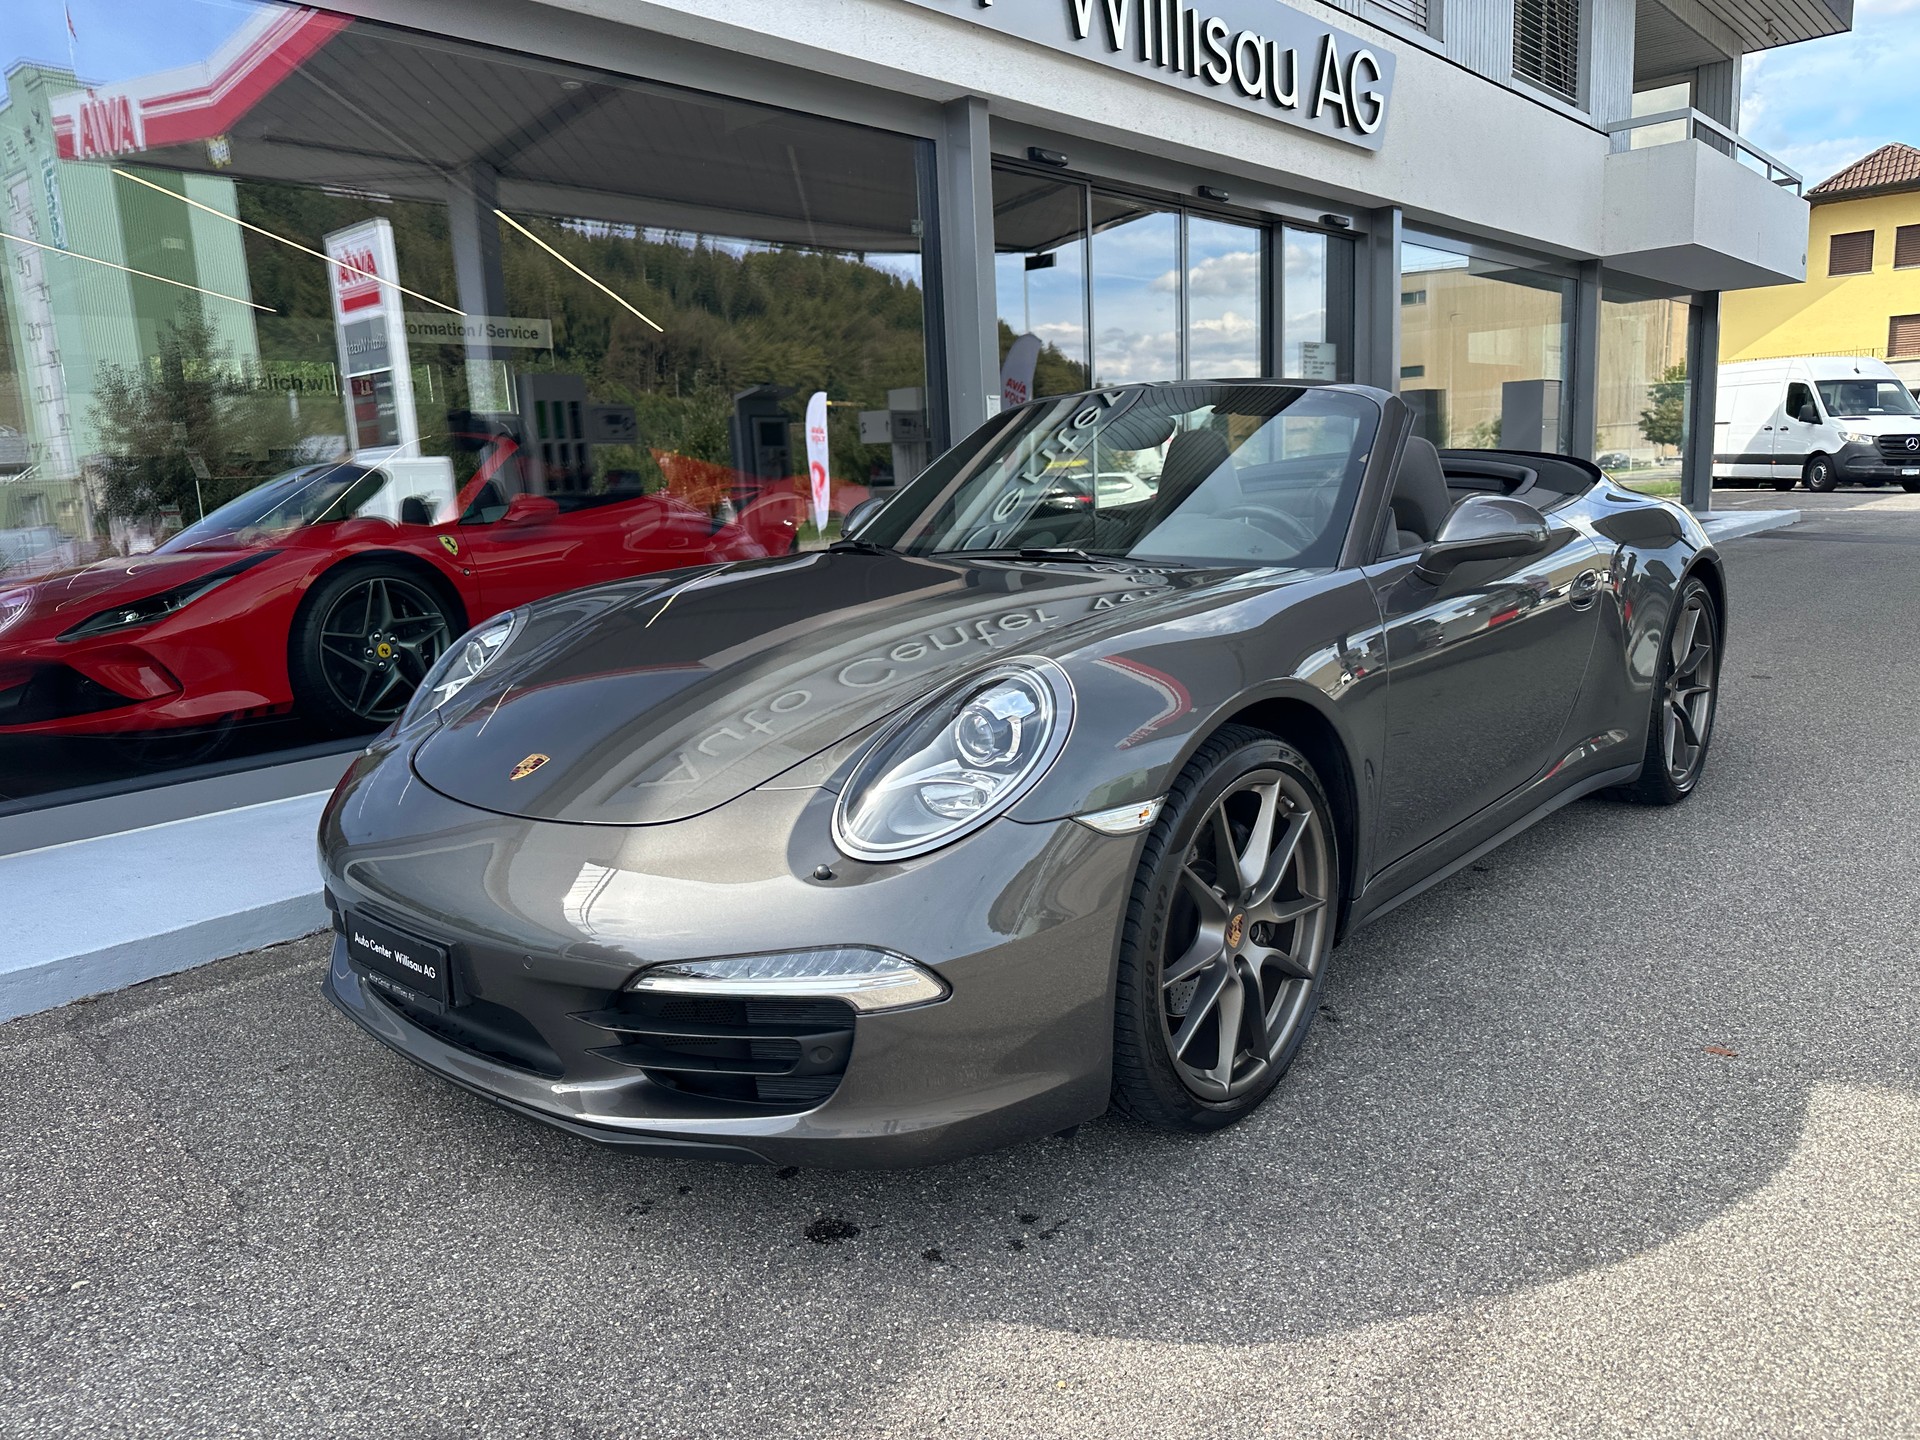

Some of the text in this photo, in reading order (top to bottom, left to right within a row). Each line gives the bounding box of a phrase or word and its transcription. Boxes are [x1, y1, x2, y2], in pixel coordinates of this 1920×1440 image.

[1311, 33, 1384, 134] AG
[404, 321, 475, 337] ormation
[486, 324, 538, 340] Service
[354, 931, 436, 979] Auto Center Willisau AG
